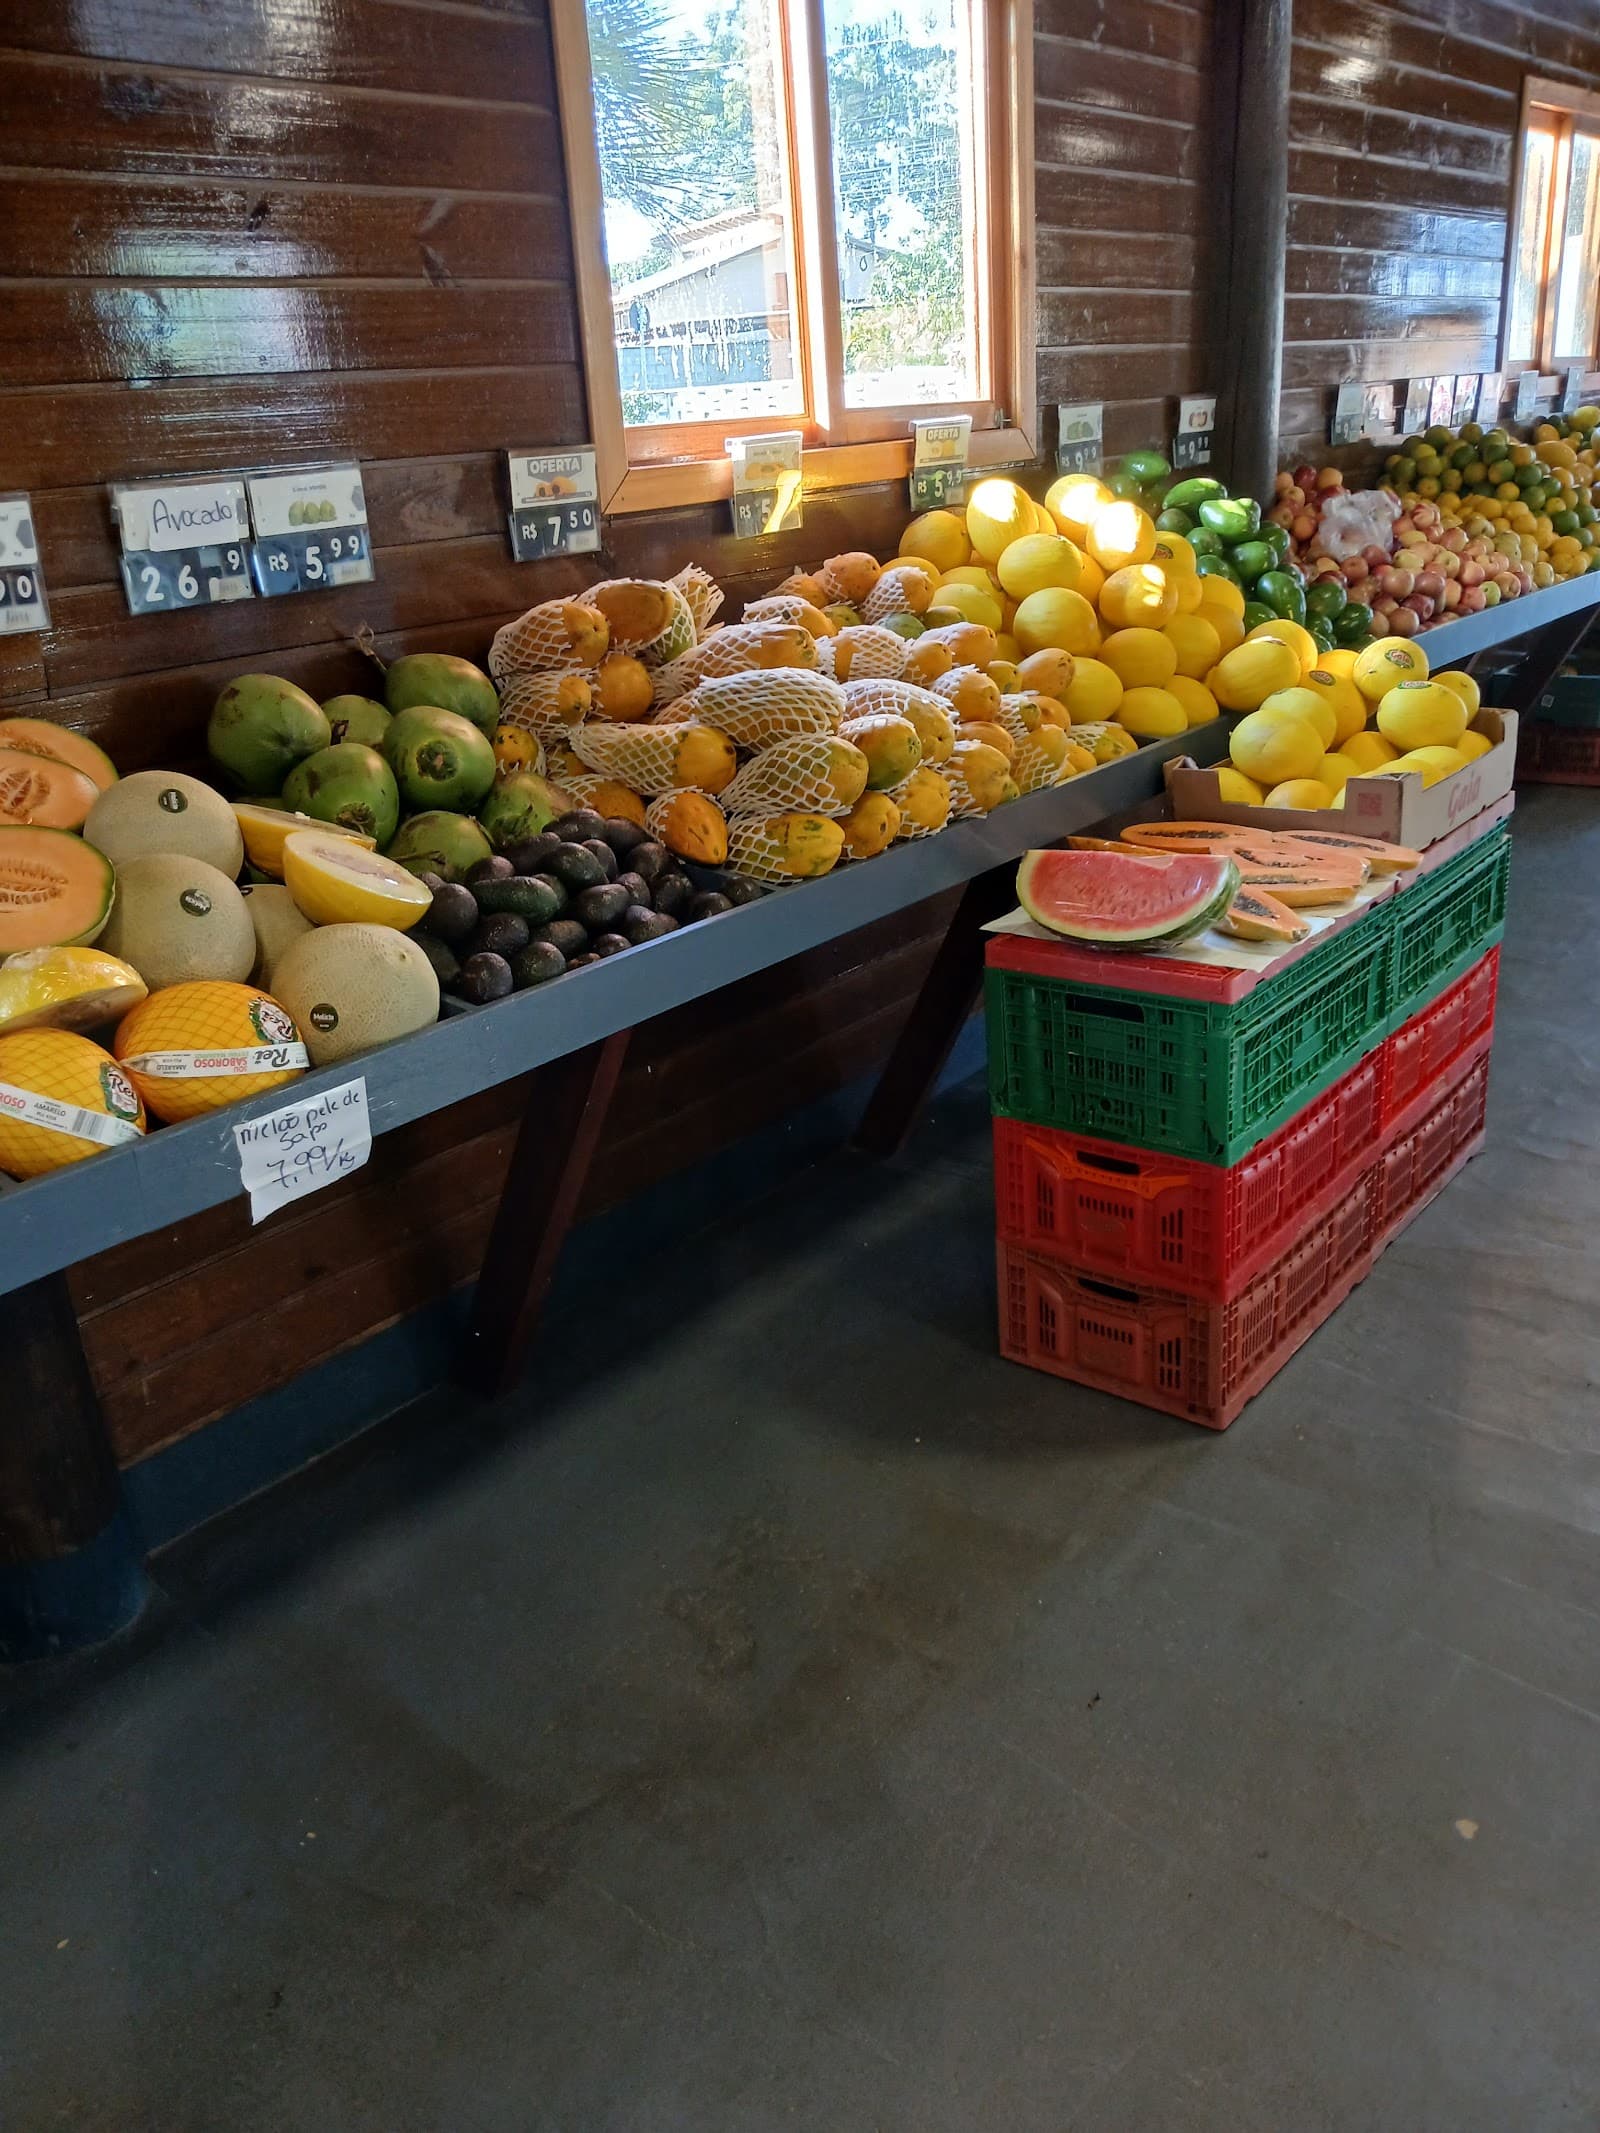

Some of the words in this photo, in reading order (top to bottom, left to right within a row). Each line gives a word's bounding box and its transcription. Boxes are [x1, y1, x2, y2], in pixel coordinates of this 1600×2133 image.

[927, 428, 960, 441] OFERTA
[529, 457, 581, 474] OFERTA
[917, 480, 927, 494] R$
[152, 498, 233, 534] Avocado
[739, 504, 751, 520] R$
[521, 522, 538, 540] R$
[547, 508, 592, 548] 7,50
[267, 552, 289, 571] R$
[305, 535, 360, 581] 5,99
[194, 1056, 248, 1069] SABOROSO
[254, 1047, 290, 1068] Rei
[33, 1102, 66, 1117] AMARELO
